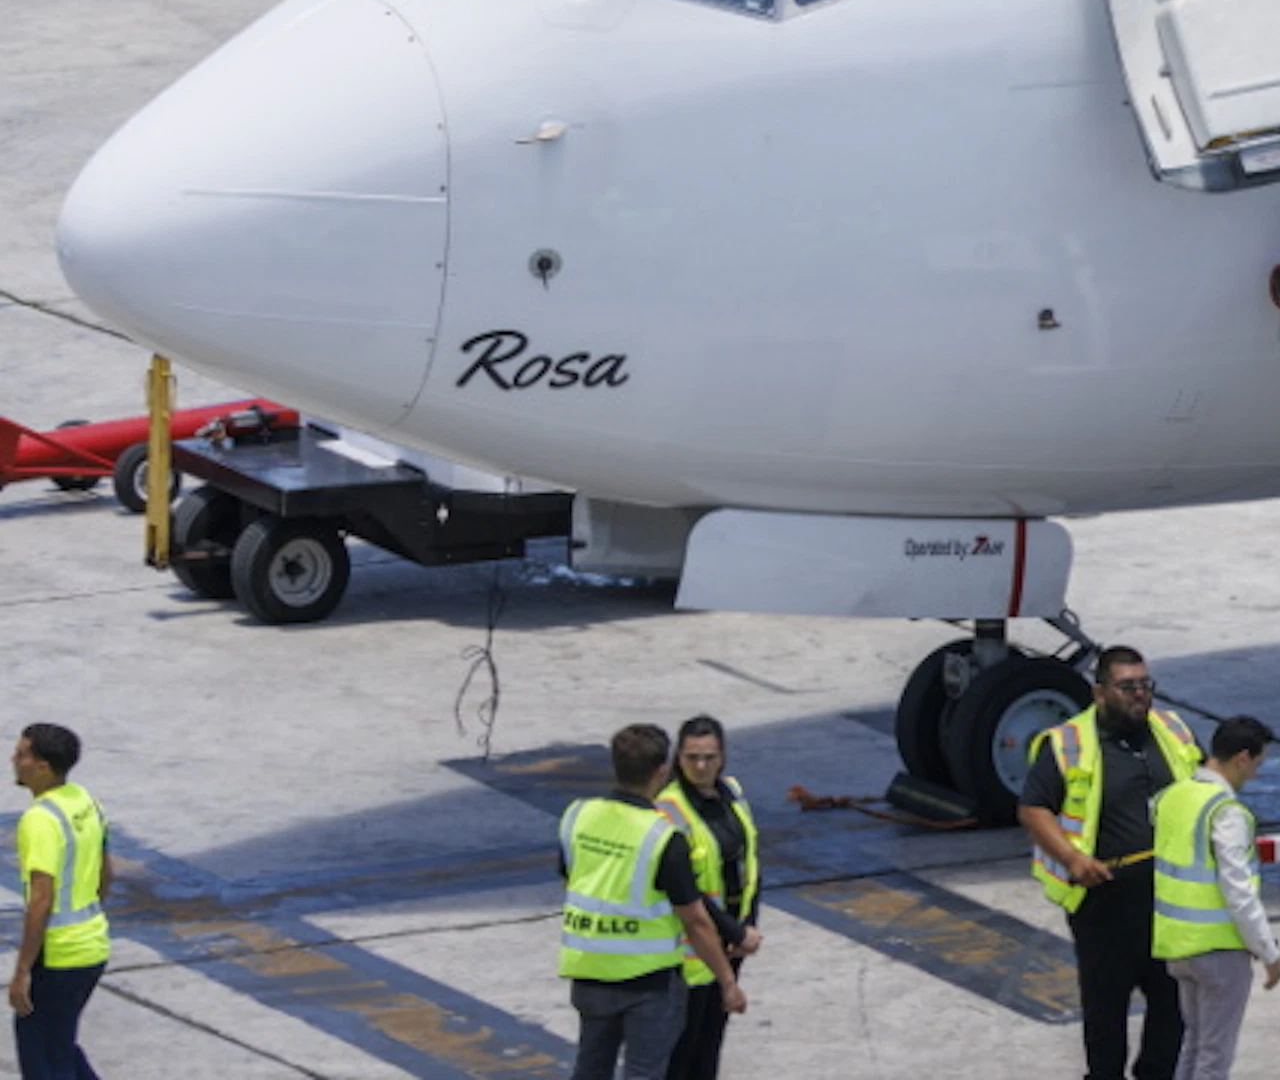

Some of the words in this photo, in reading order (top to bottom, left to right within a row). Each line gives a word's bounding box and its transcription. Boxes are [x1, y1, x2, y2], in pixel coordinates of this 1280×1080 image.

[456, 329, 630, 391] Rosa
[904, 537, 951, 561] Operated
[597, 918, 641, 934] LLC
